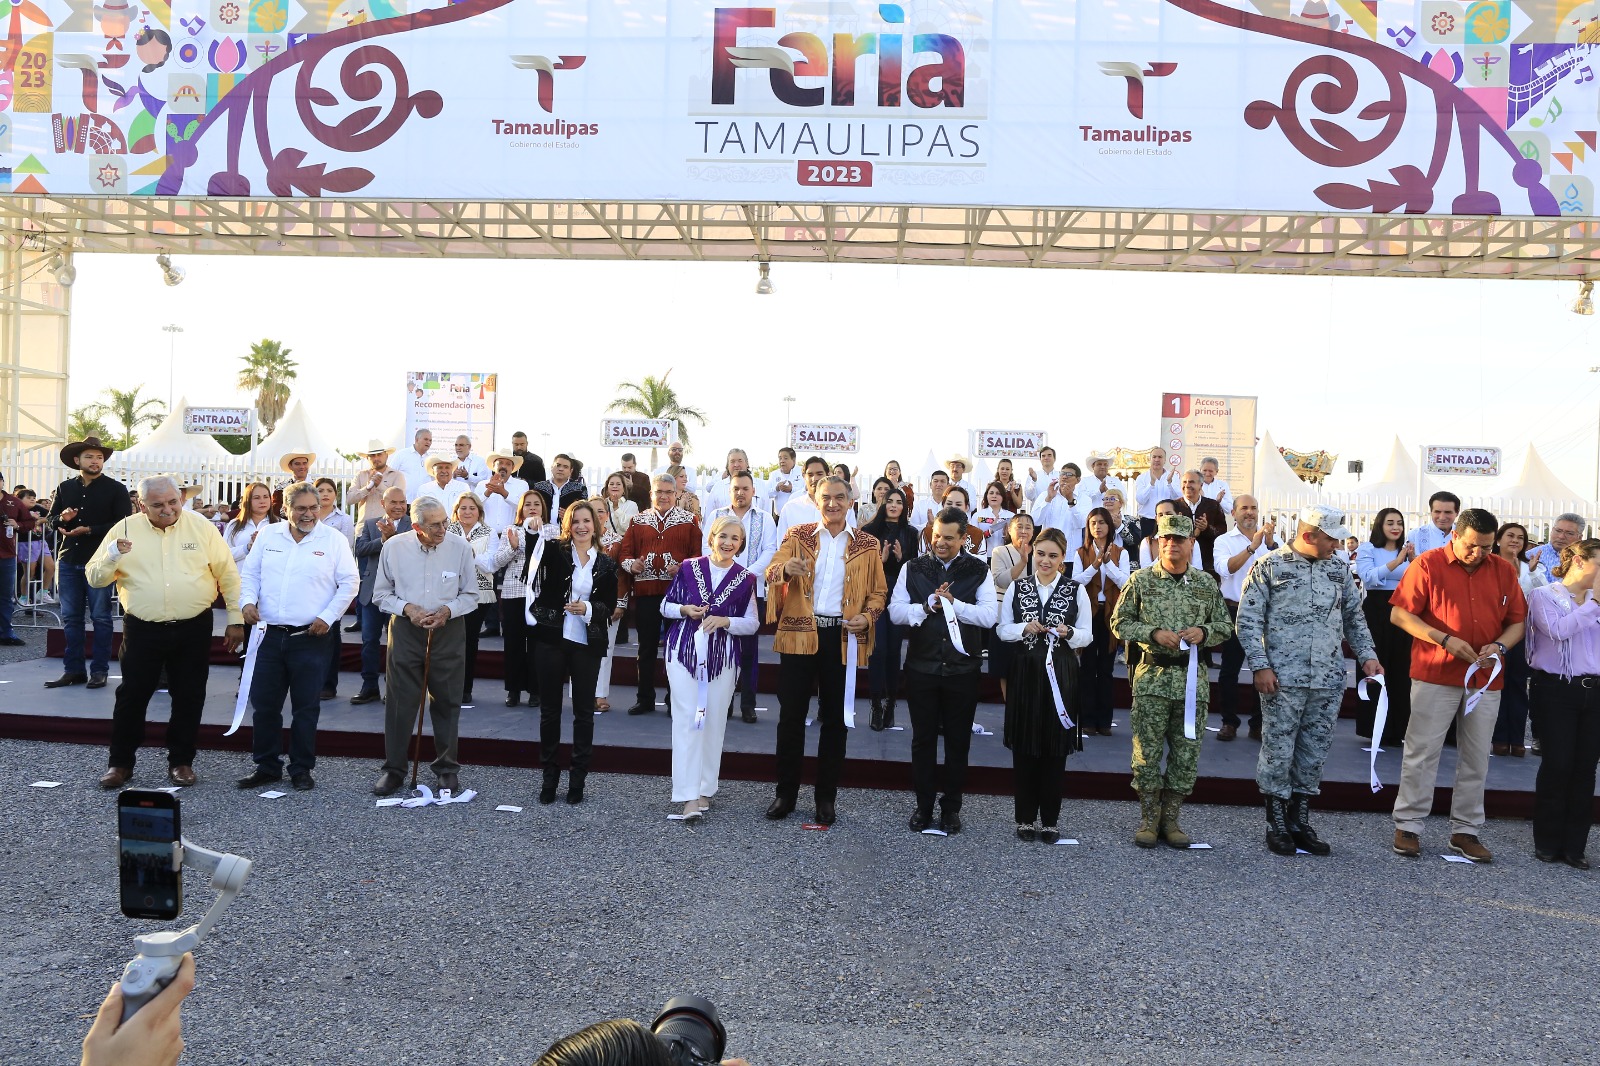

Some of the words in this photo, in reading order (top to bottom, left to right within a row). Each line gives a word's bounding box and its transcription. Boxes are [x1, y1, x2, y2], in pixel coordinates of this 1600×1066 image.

[21, 52, 47, 69] 20
[711, 3, 965, 109] Feria
[20, 71, 45, 88] 23
[491, 118, 599, 140] Tamaulipas
[694, 121, 981, 158] TAMAULIPAS
[1079, 125, 1192, 146] Tamaulipas
[509, 141, 542, 149] Gobierno
[542, 141, 554, 149] del
[555, 141, 580, 149] Estado
[1098, 147, 1132, 155] Gobierno
[1146, 148, 1172, 156] Estado
[807, 165, 862, 183] 2023
[414, 400, 485, 410] Recomendaciones
[1171, 397, 1181, 414] 1
[1194, 398, 1225, 407] Acceso
[1194, 407, 1232, 417] principal
[192, 414, 241, 425] ENTRADA
[612, 426, 659, 437] SALIDA
[799, 430, 847, 442] SALIDA
[986, 436, 1034, 449] SALIDA
[1436, 454, 1490, 465] ENTRADA
